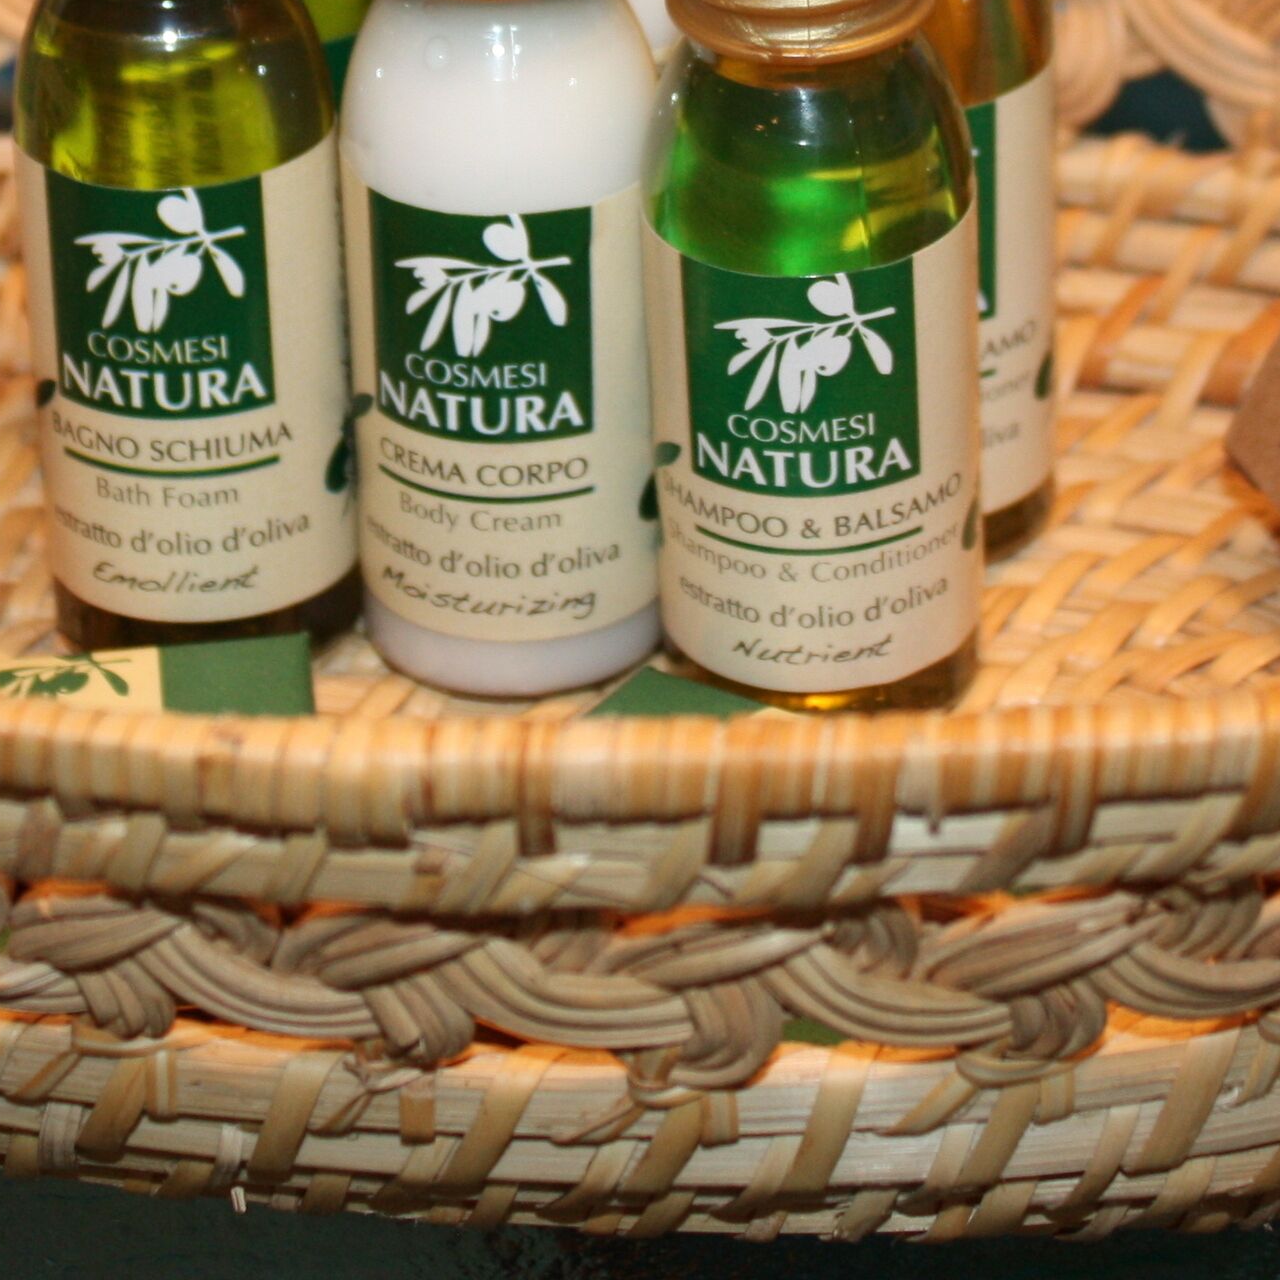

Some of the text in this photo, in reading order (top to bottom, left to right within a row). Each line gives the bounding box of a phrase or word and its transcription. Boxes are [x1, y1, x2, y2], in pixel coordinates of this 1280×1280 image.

[88, 332, 228, 364] COSMESI
[405, 353, 547, 389] COSMESI
[63, 352, 268, 411] NATURA
[380, 370, 584, 435] NATURA
[52, 410, 293, 462] BAGNO SCHIUMA
[727, 413, 875, 444] COSMESI
[380, 437, 589, 487] CREMA CORPO
[697, 432, 912, 488] NATURA
[96, 477, 239, 508] Bath Foam
[399, 490, 561, 532] Body Cream
[800, 519, 821, 539] &
[835, 473, 962, 537] BALSAMO
[131, 528, 212, 556] d'olio
[222, 515, 310, 545] d'oliva
[779, 563, 798, 583] &
[811, 524, 961, 583] Conditioner
[93, 560, 259, 593] Emollient
[440, 550, 520, 578] d'olio
[531, 543, 620, 578] d'oliva
[382, 565, 596, 619] Moisturizing
[679, 575, 948, 629] estratto d'olio d'oliva
[733, 634, 893, 664] Nutrient
